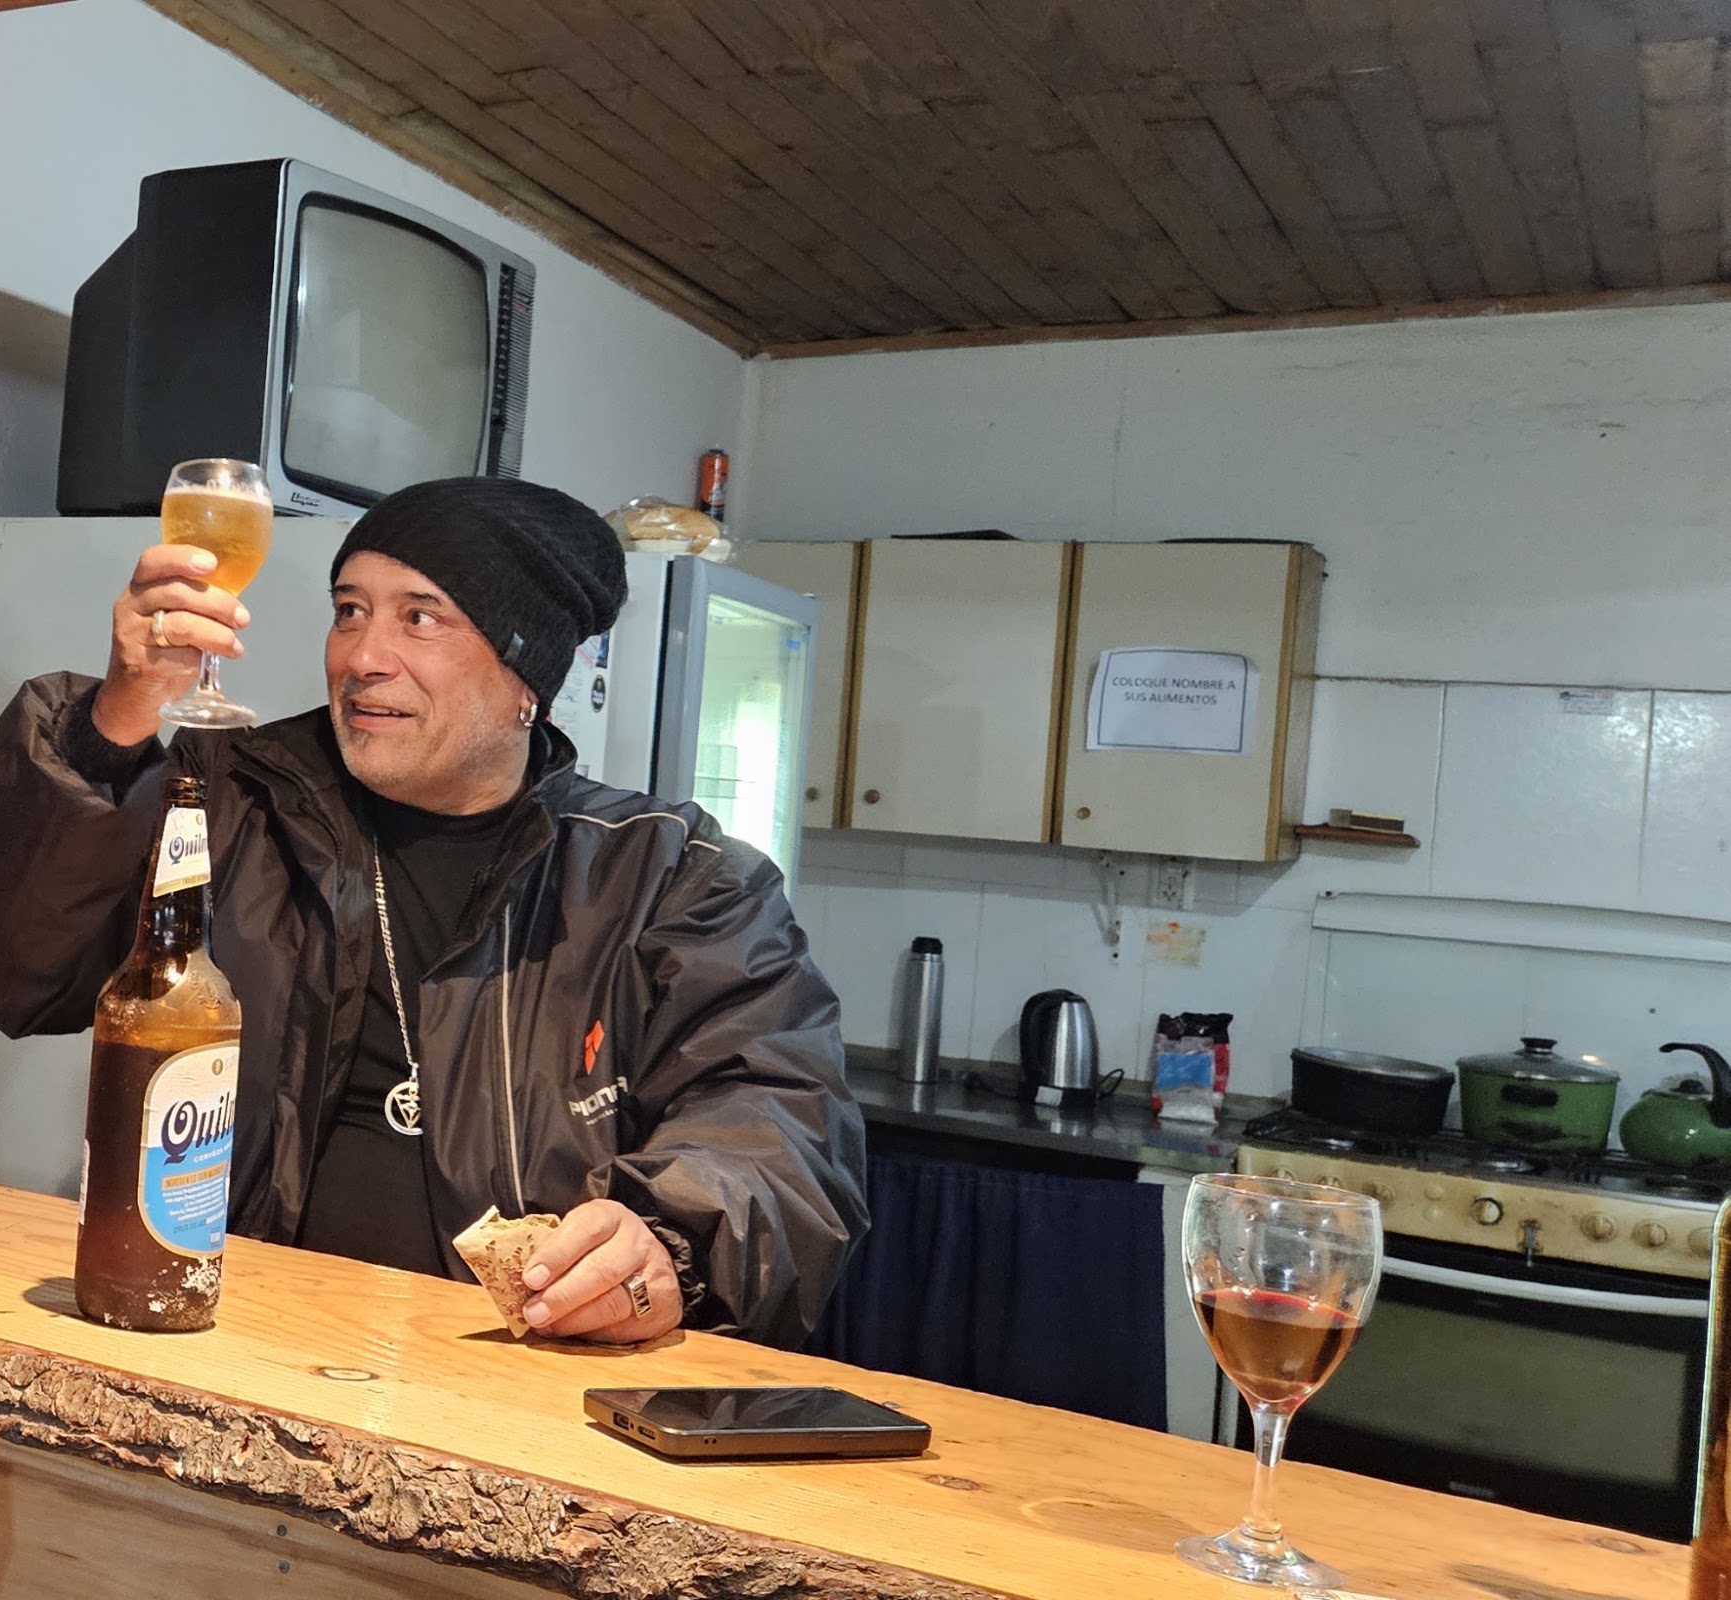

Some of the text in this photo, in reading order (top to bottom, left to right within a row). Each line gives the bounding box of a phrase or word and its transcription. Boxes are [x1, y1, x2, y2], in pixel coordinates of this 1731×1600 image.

[1111, 676, 1236, 690] COLOQUE NOMBRE A
[1124, 691, 1217, 705] SUS ALIMENTOS
